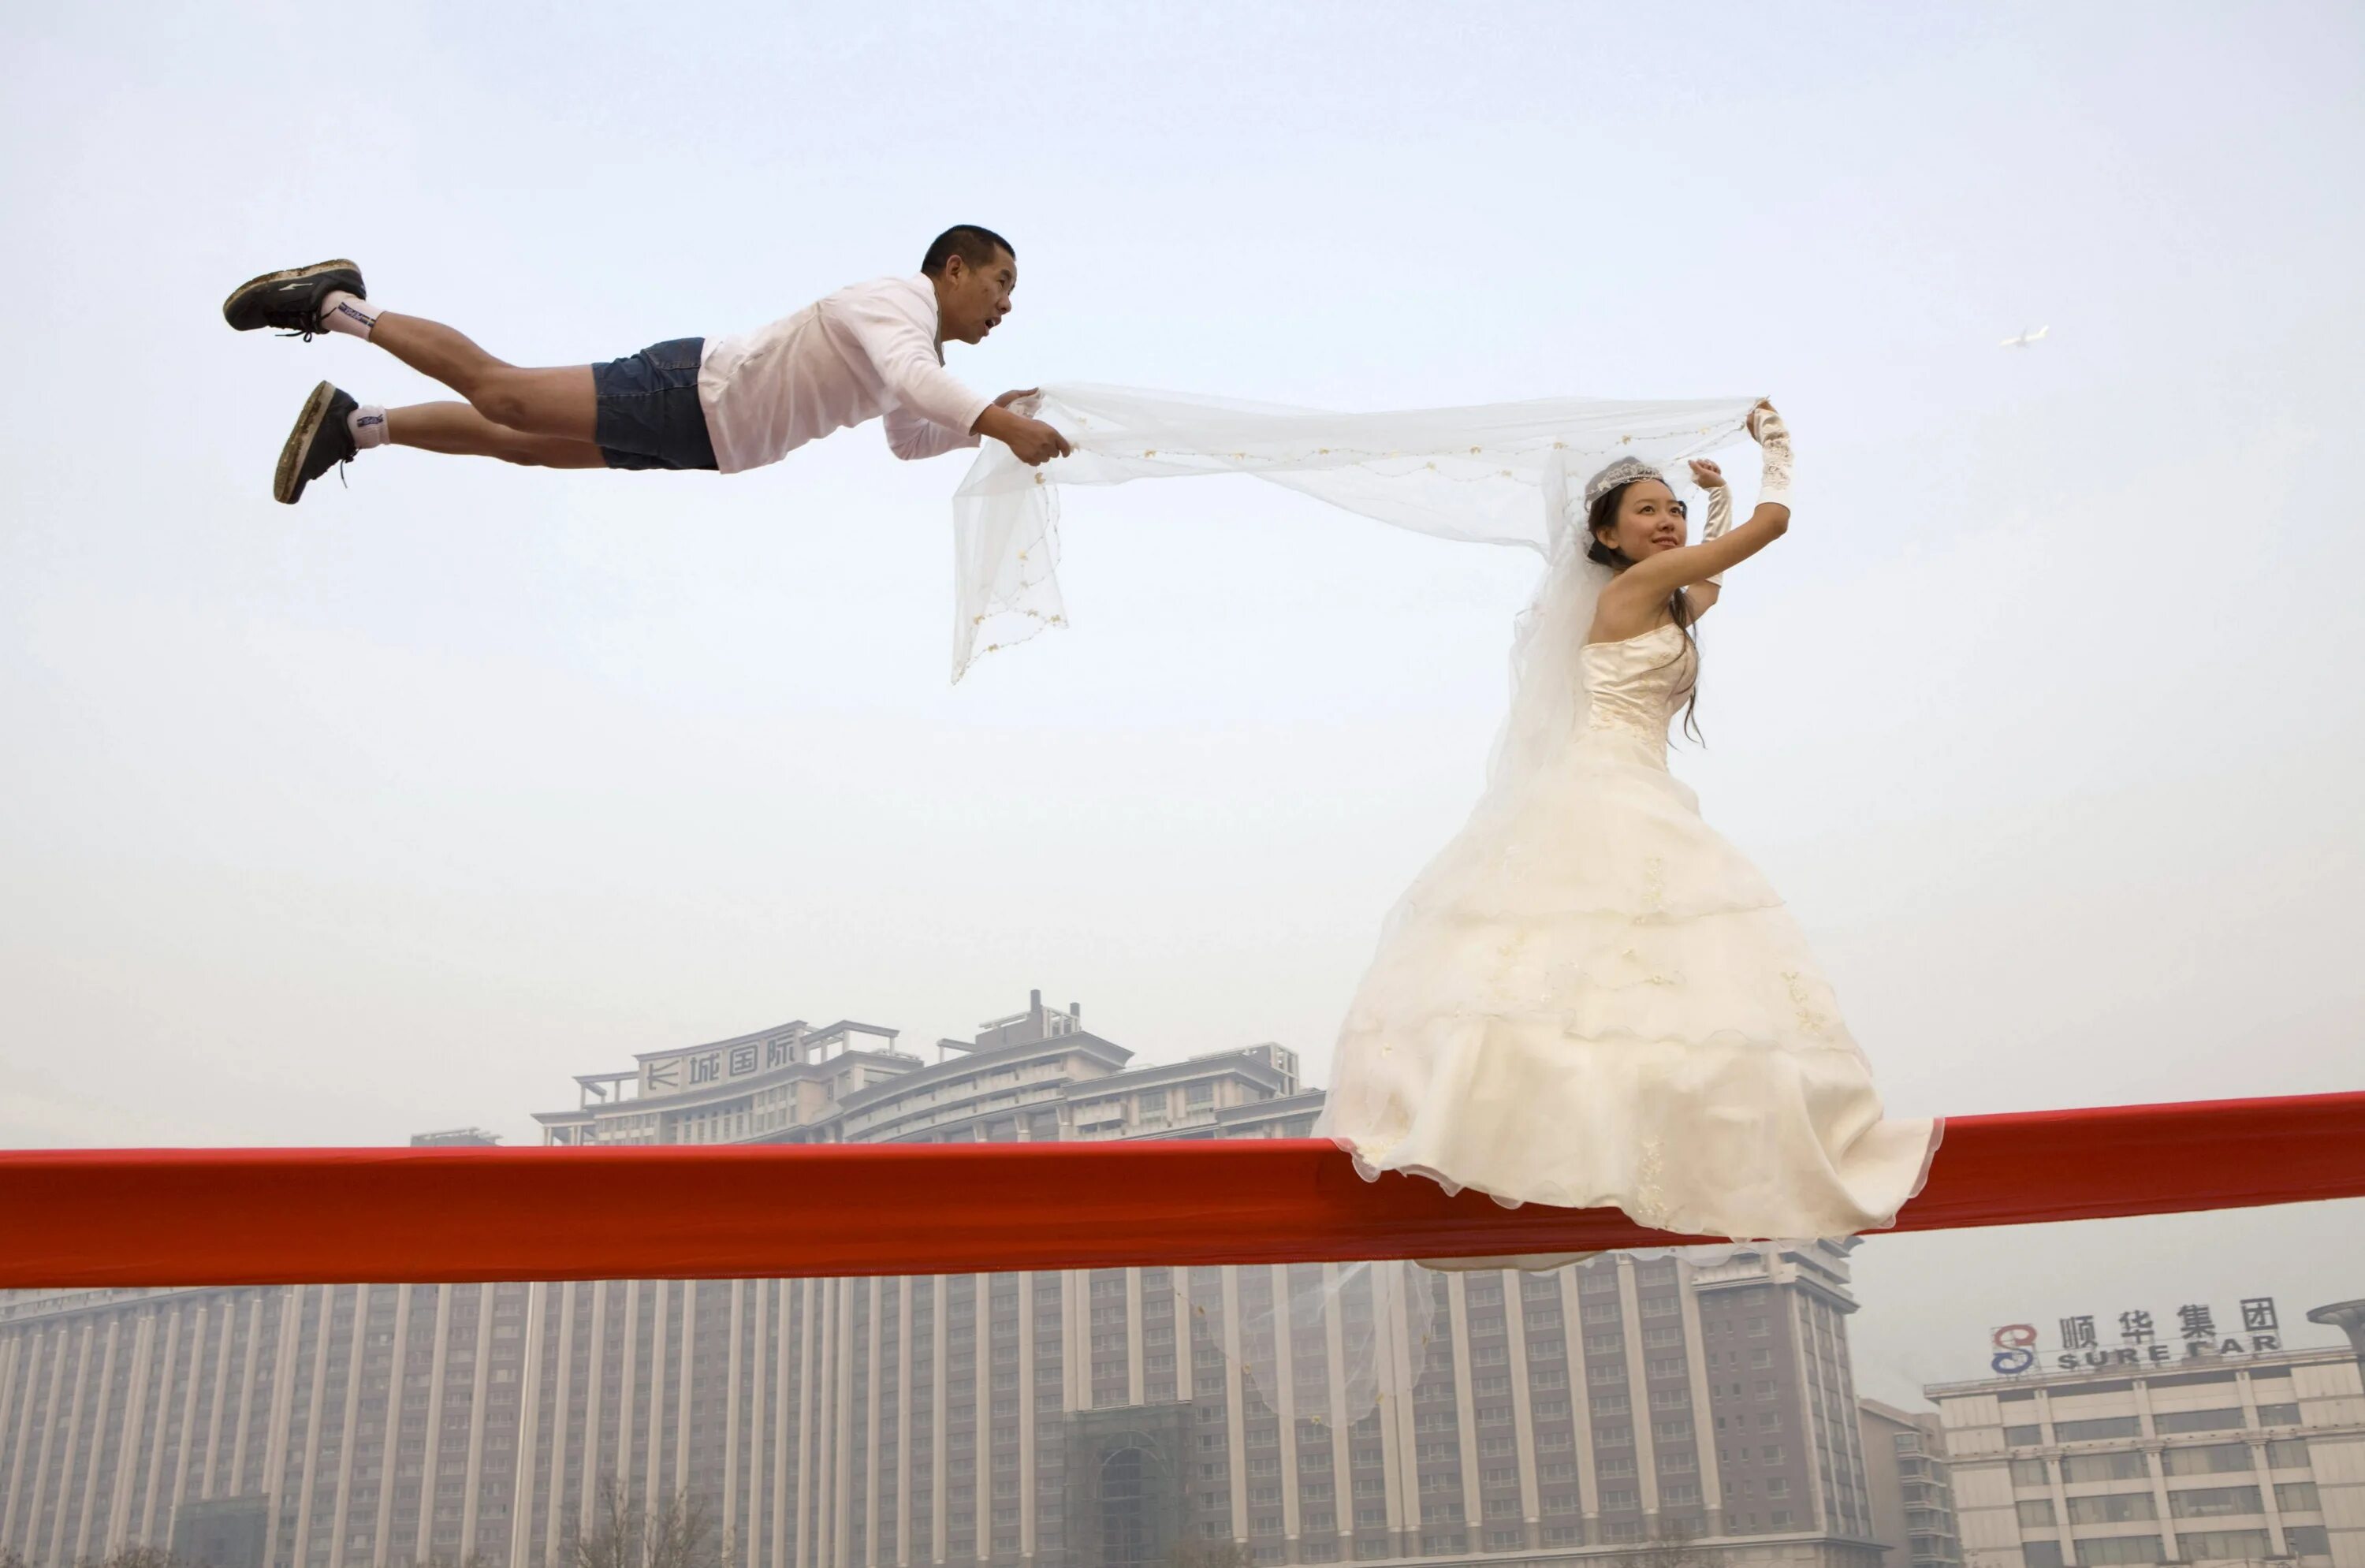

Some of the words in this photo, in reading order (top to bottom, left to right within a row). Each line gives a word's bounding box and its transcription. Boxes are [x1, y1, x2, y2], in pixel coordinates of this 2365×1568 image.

[647, 1034, 795, 1090] 长城国际
[2058, 1297, 2279, 1349] 顺华集团
